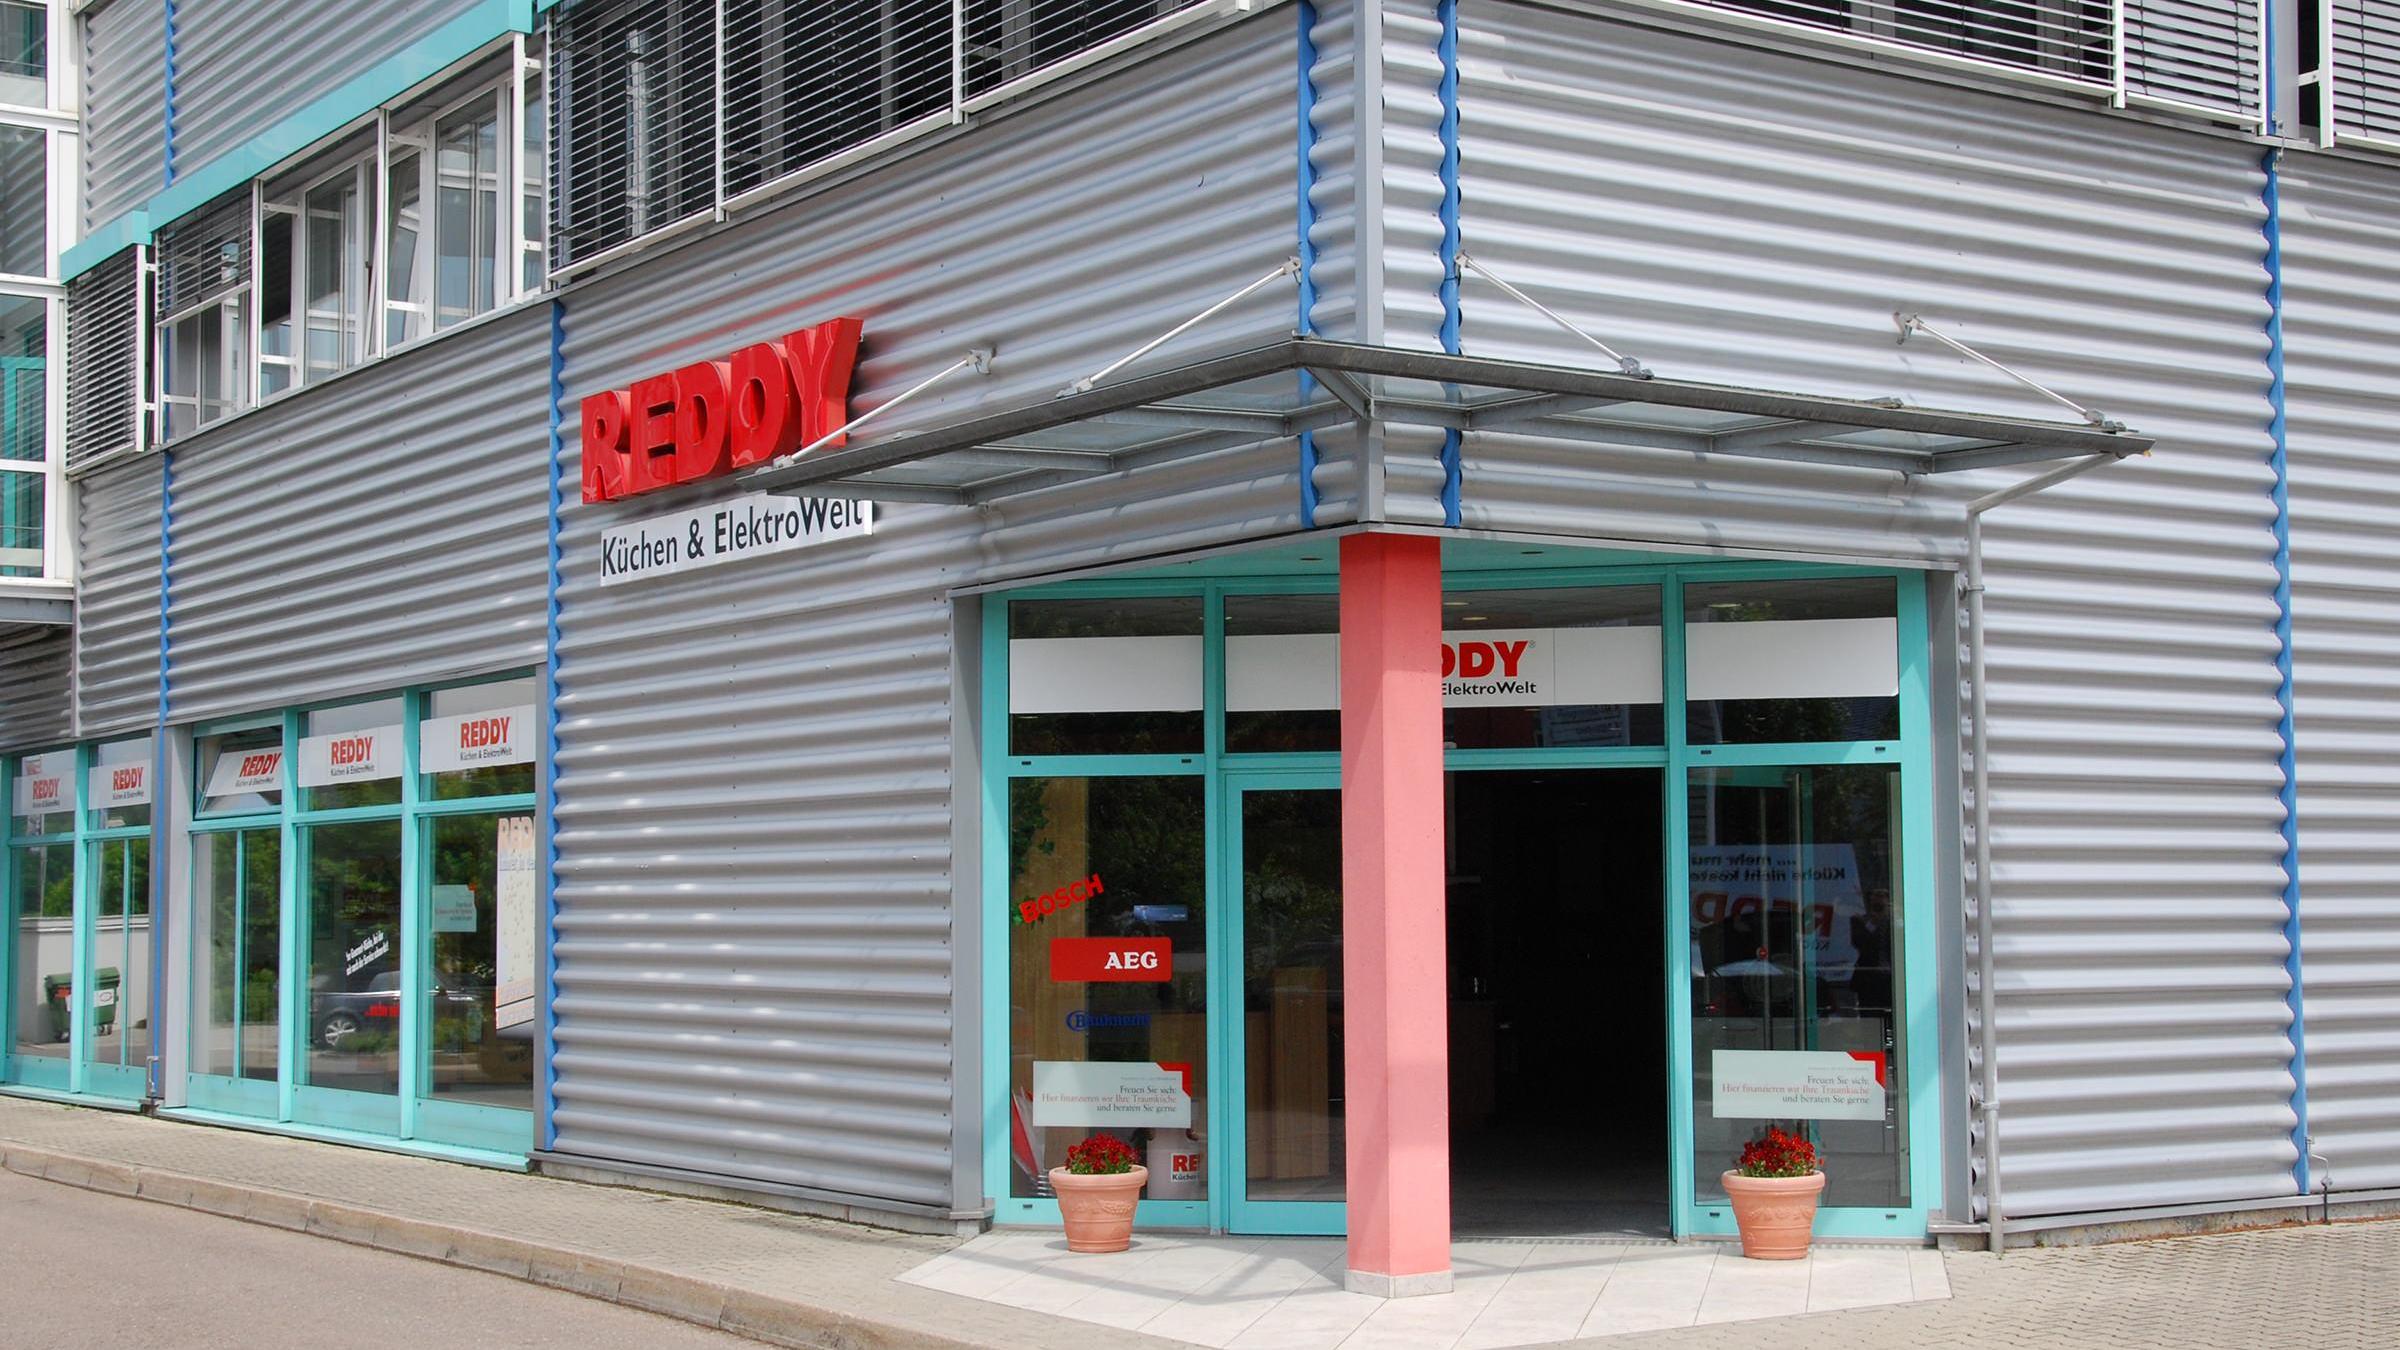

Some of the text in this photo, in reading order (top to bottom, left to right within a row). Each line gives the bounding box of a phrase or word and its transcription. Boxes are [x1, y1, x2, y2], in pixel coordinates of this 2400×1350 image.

[581, 317, 864, 505] REDDY
[602, 498, 863, 577] Küchen & ElektroWelt
[461, 716, 511, 748] REDDY
[331, 736, 373, 765] REDDY
[239, 752, 282, 778] REDDY
[32, 778, 60, 800] REDDY
[113, 766, 144, 791] REDDY
[1019, 873, 1104, 923] BOSCH
[1104, 951, 1158, 970] AEG
[1120, 1085, 1145, 1094] Freuen
[1147, 1085, 1159, 1094] Sie
[1807, 1075, 1835, 1085] Freuen
[1836, 1075, 1849, 1085] Sie
[1096, 1103, 1111, 1112] und
[1113, 1104, 1141, 1112] beraten
[1156, 1106, 1177, 1114] gerne
[1782, 1094, 1869, 1105] und beraten Sie gerne
